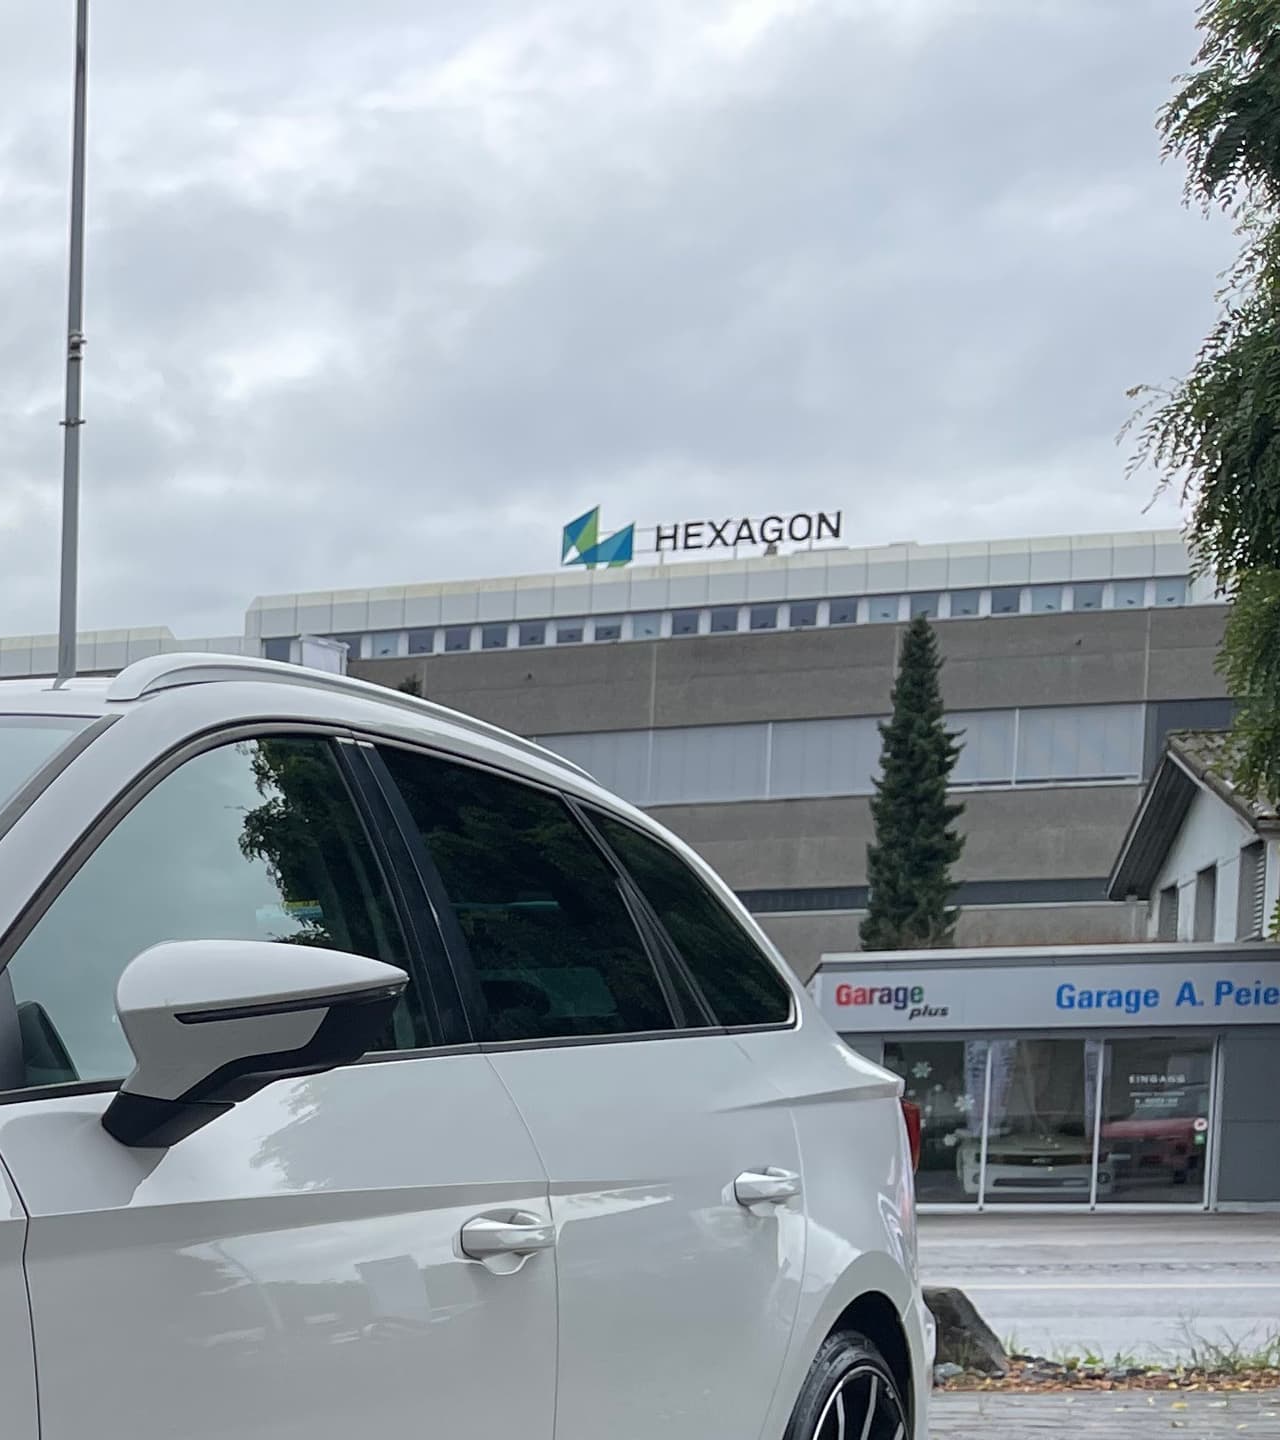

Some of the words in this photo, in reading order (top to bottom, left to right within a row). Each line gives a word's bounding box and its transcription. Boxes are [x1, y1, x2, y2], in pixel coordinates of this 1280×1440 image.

[655, 511, 842, 552] HEXAGON
[835, 983, 925, 1009] Garage
[1056, 983, 1160, 1014] Garage
[1175, 981, 1204, 1007] A.
[909, 1004, 949, 1020] plus
